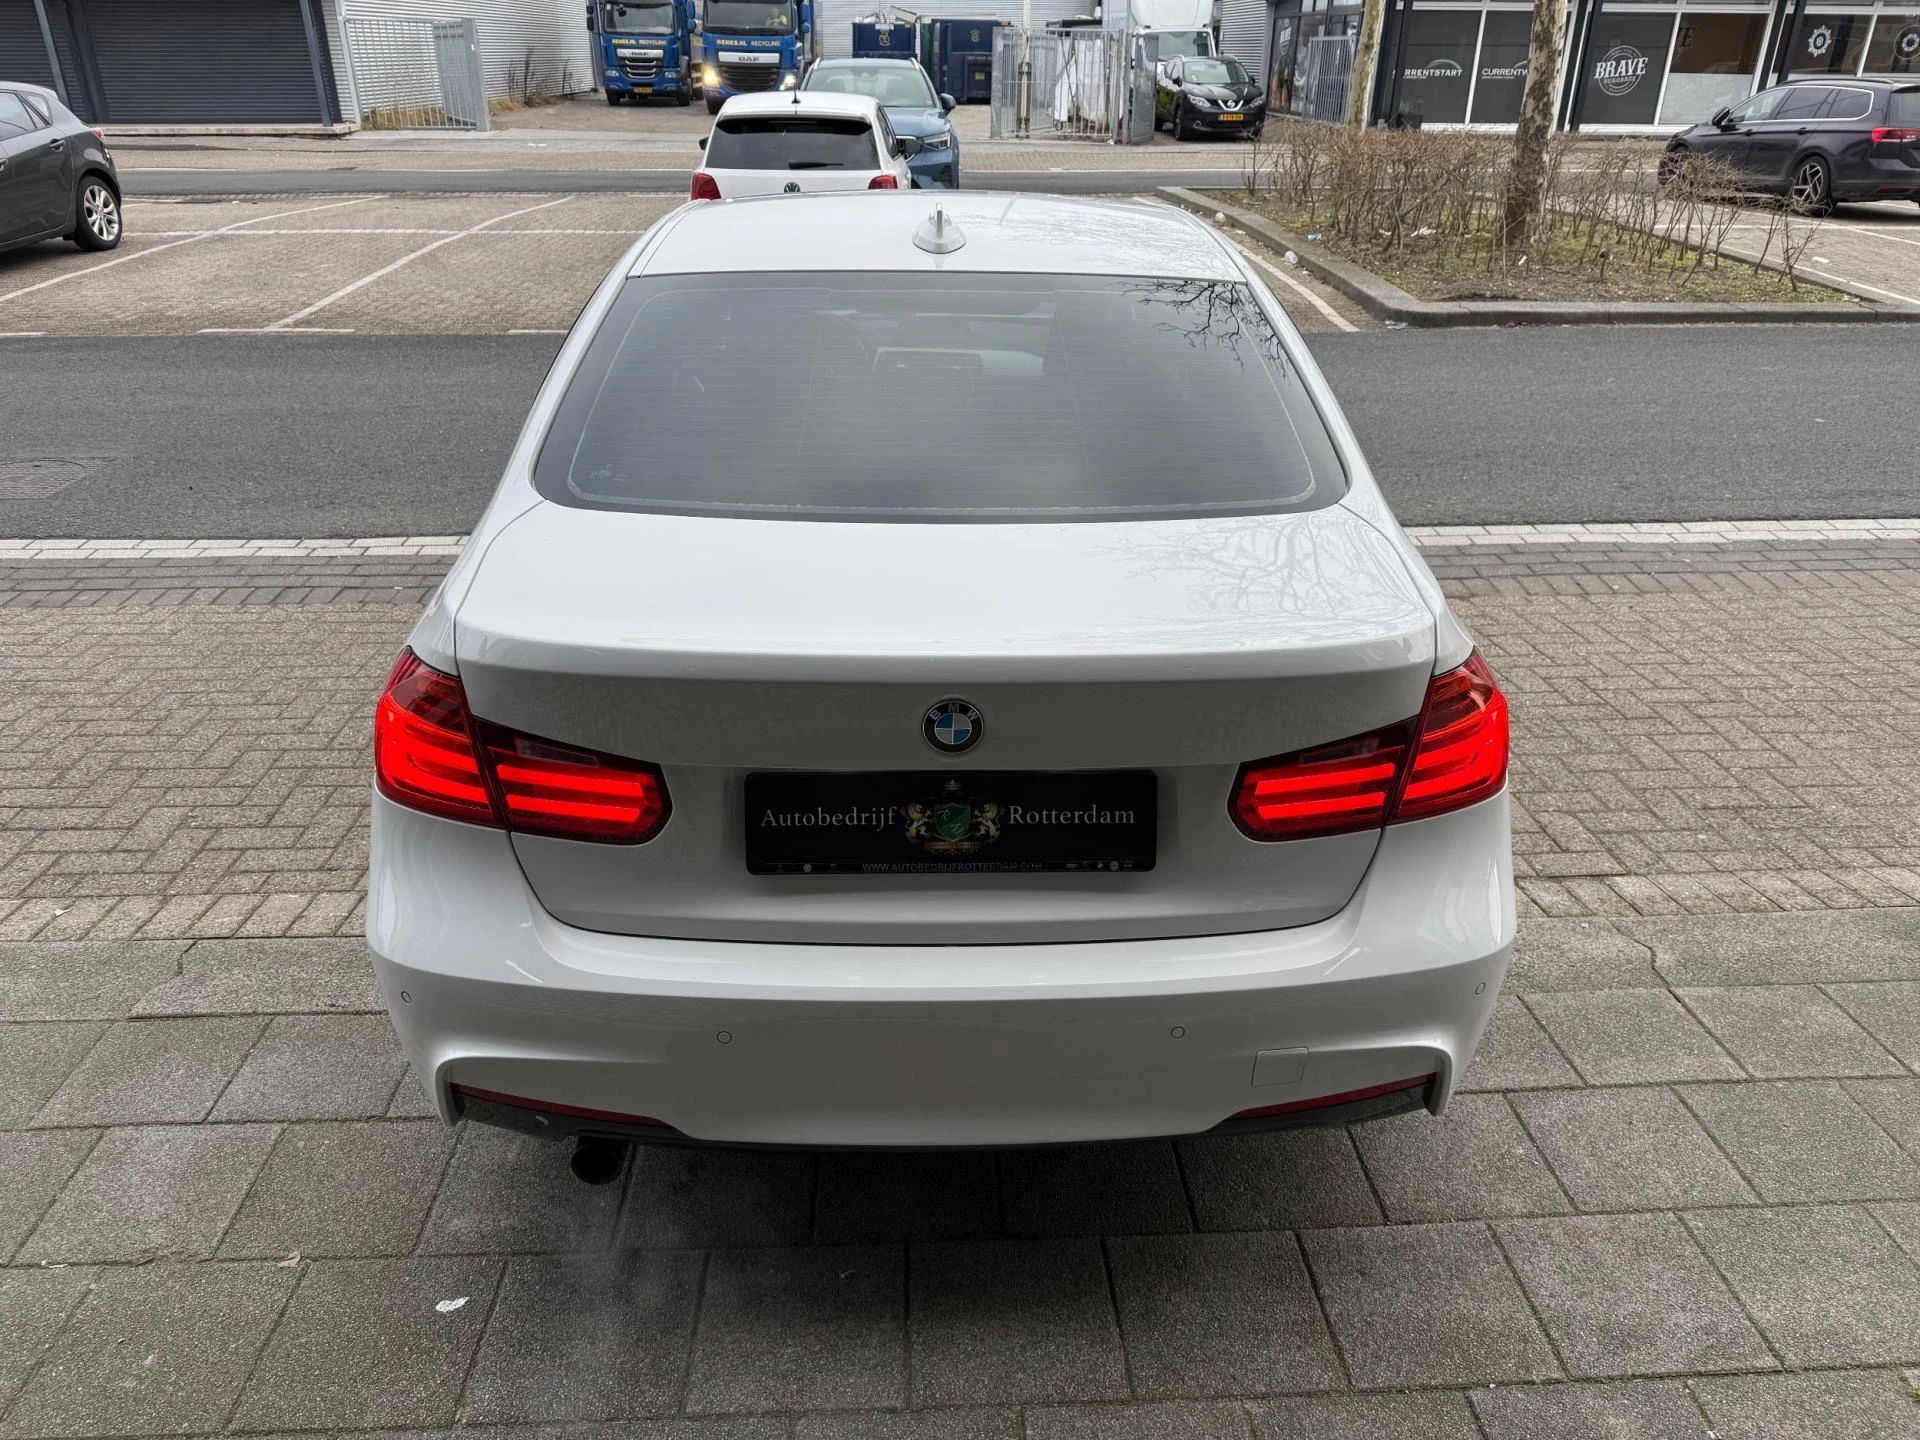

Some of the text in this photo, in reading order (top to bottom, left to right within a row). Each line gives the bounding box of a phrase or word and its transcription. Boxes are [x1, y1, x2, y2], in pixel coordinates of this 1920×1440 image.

[1392, 68, 1463, 77] RRENTSTART
[1481, 68, 1529, 76] CURRENTW
[1594, 57, 1648, 79] BRAVE
[929, 703, 979, 721] BMW
[760, 804, 1136, 832] Autobedrijf Rotterdam
